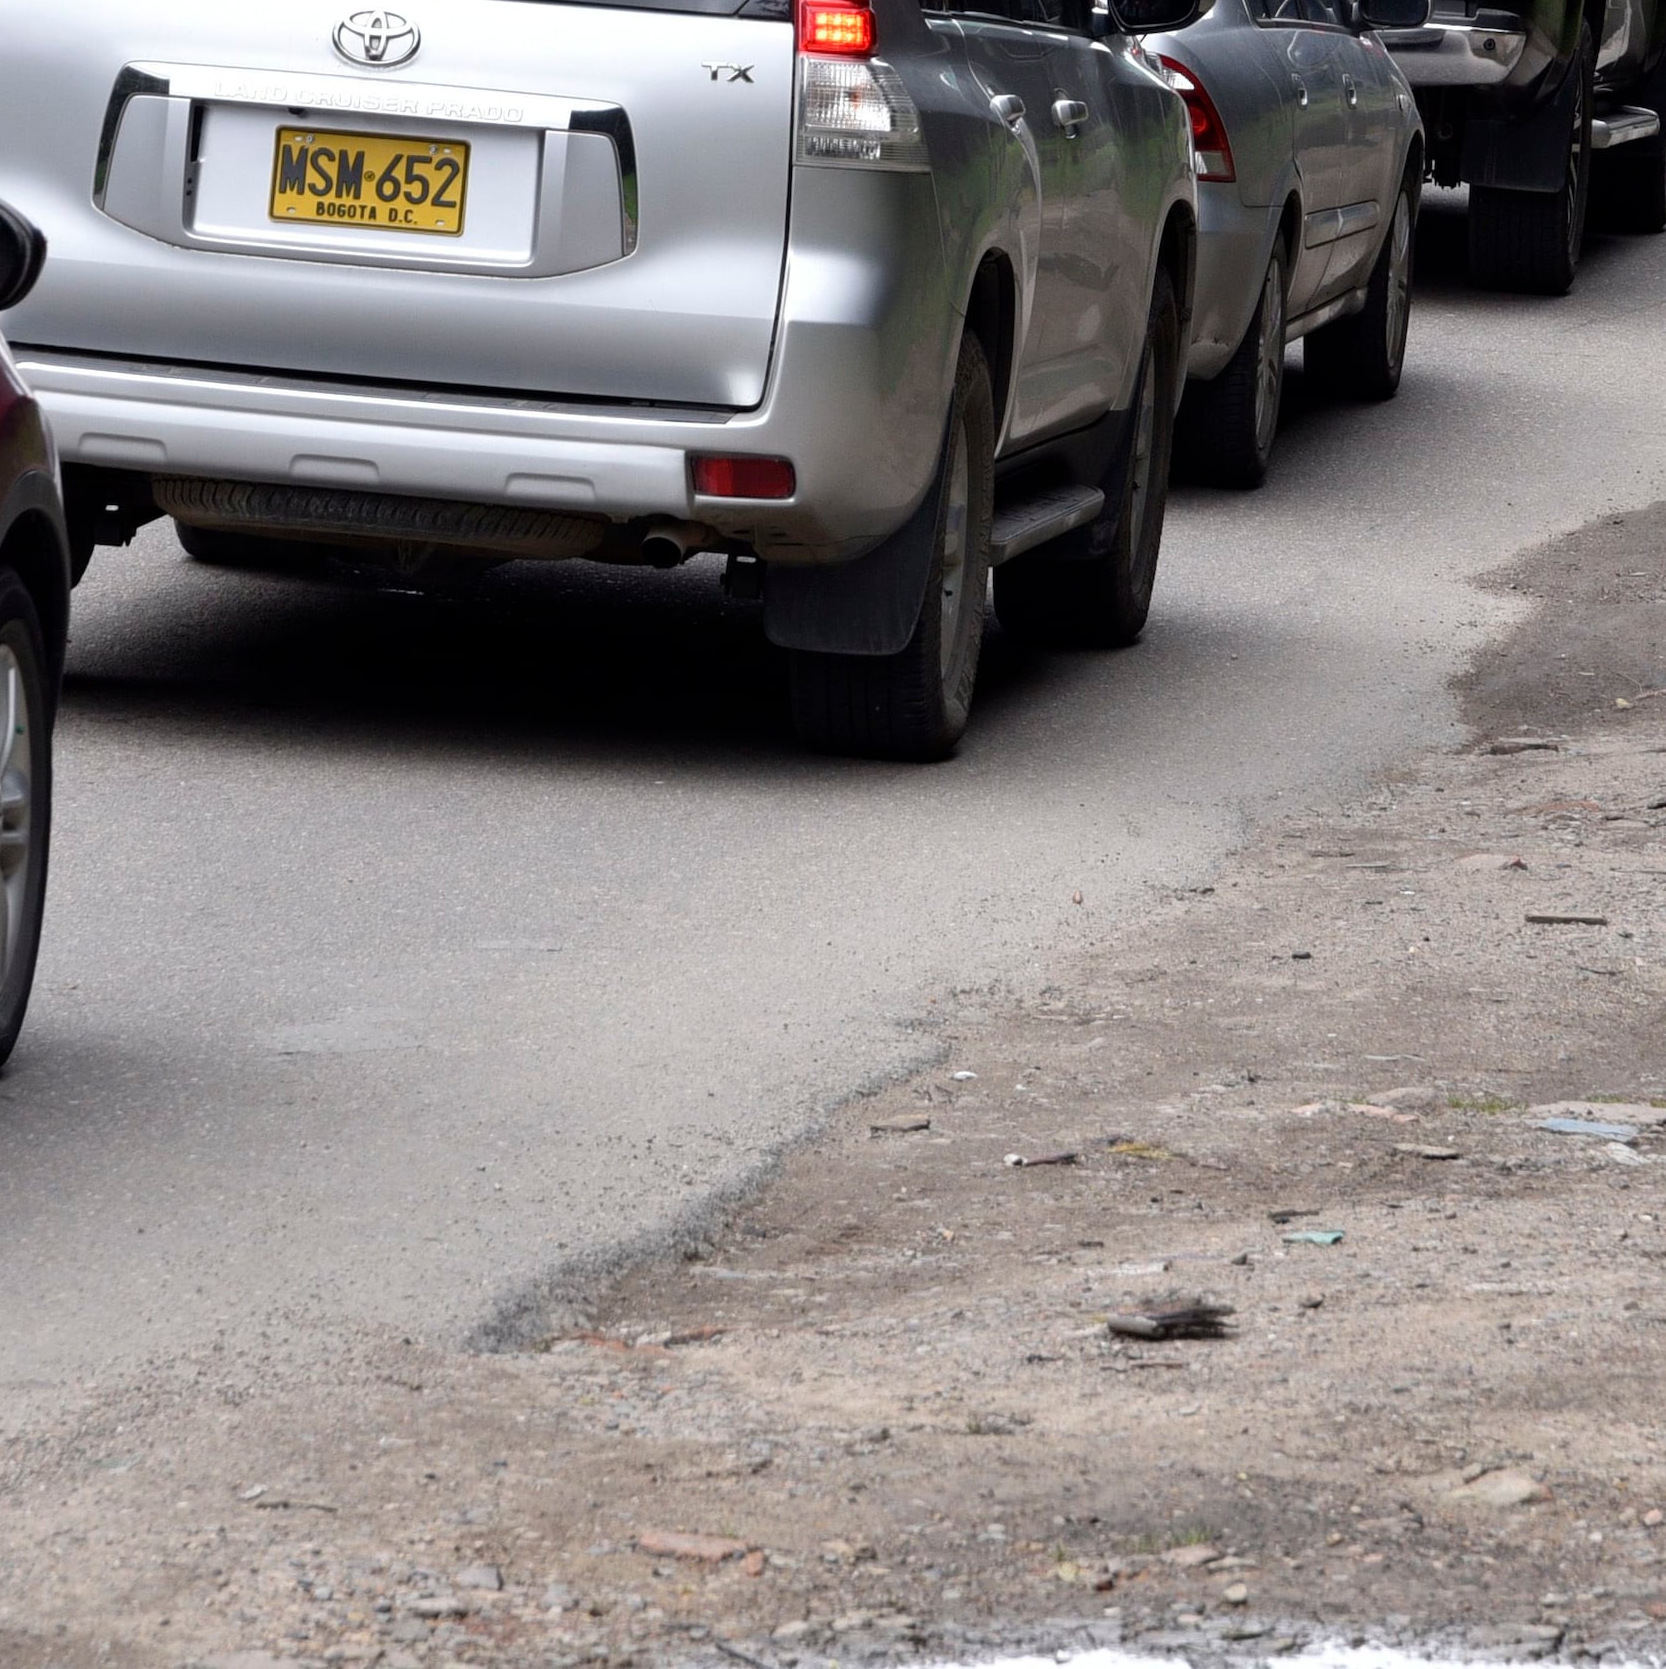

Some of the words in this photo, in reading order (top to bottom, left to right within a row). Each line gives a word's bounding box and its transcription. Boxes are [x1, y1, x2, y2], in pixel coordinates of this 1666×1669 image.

[701, 60, 755, 83] TX
[214, 81, 287, 104] LAND
[294, 89, 419, 113] CRUISER
[426, 101, 524, 123] PRADO
[315, 201, 377, 221] BOGOTA
[388, 208, 418, 225] D.C.
